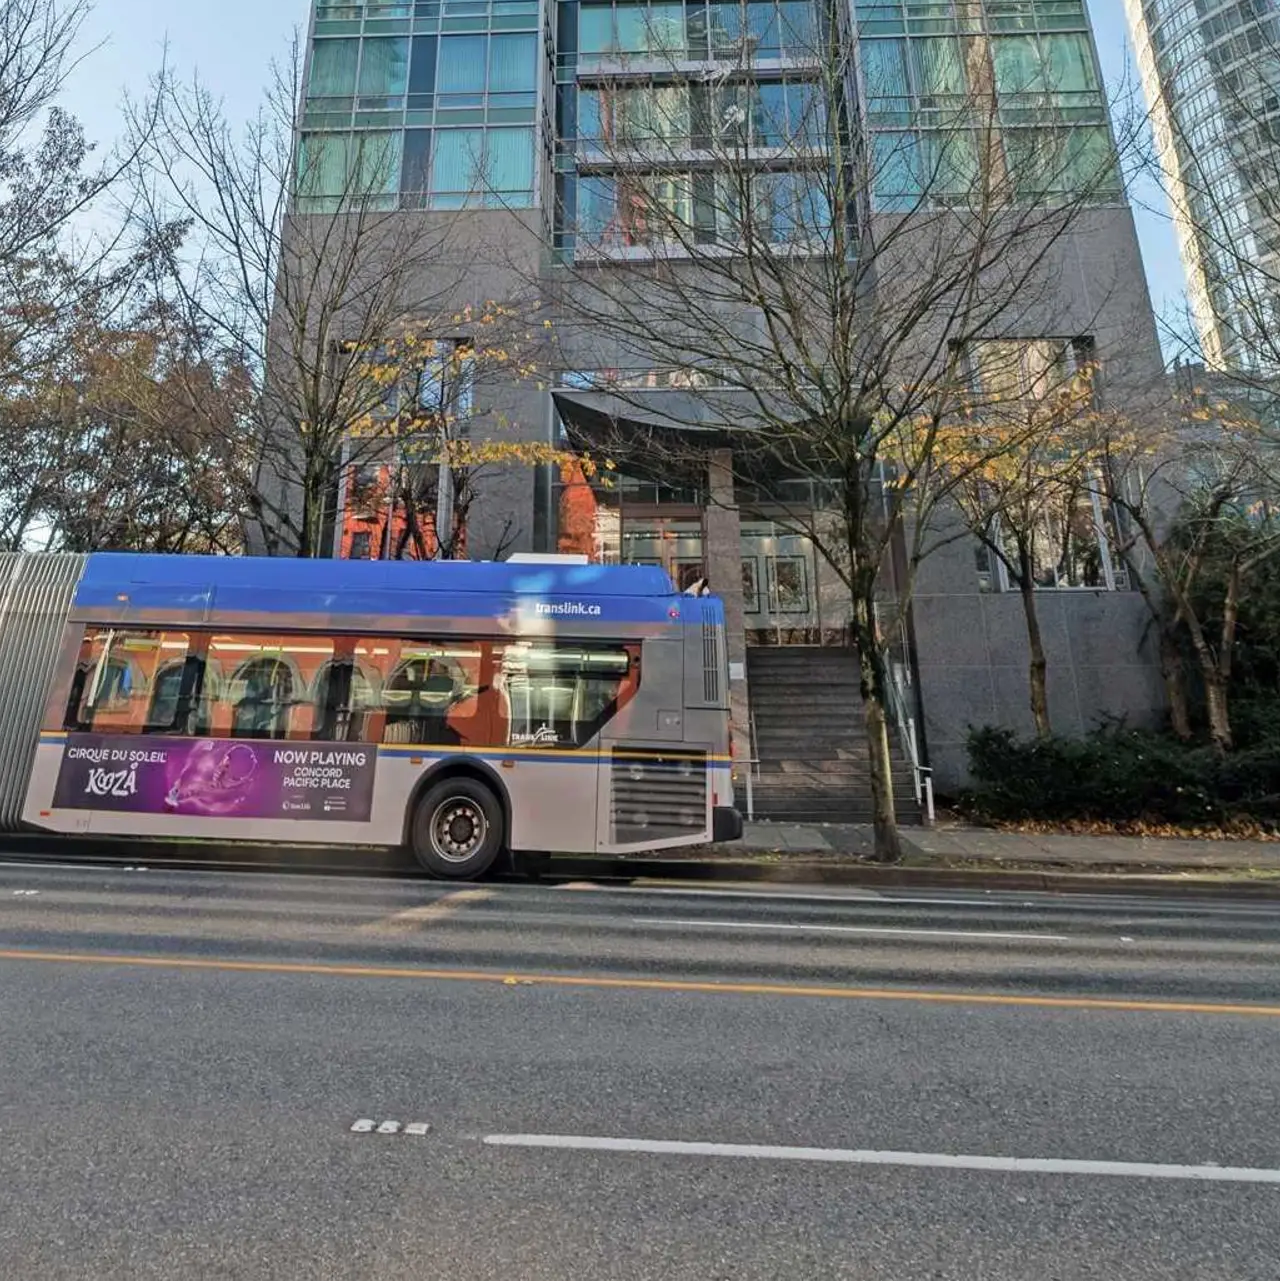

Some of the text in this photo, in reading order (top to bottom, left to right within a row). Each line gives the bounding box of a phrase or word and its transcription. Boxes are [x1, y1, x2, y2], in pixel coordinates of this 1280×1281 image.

[535, 602, 601, 615] translink.ca
[68, 748, 168, 763] CIRQUE DU SOLEIL
[273, 750, 366, 766] NOW PLAYING
[293, 767, 343, 778] CONCORD
[283, 777, 351, 789] PACIFIC PLACE
